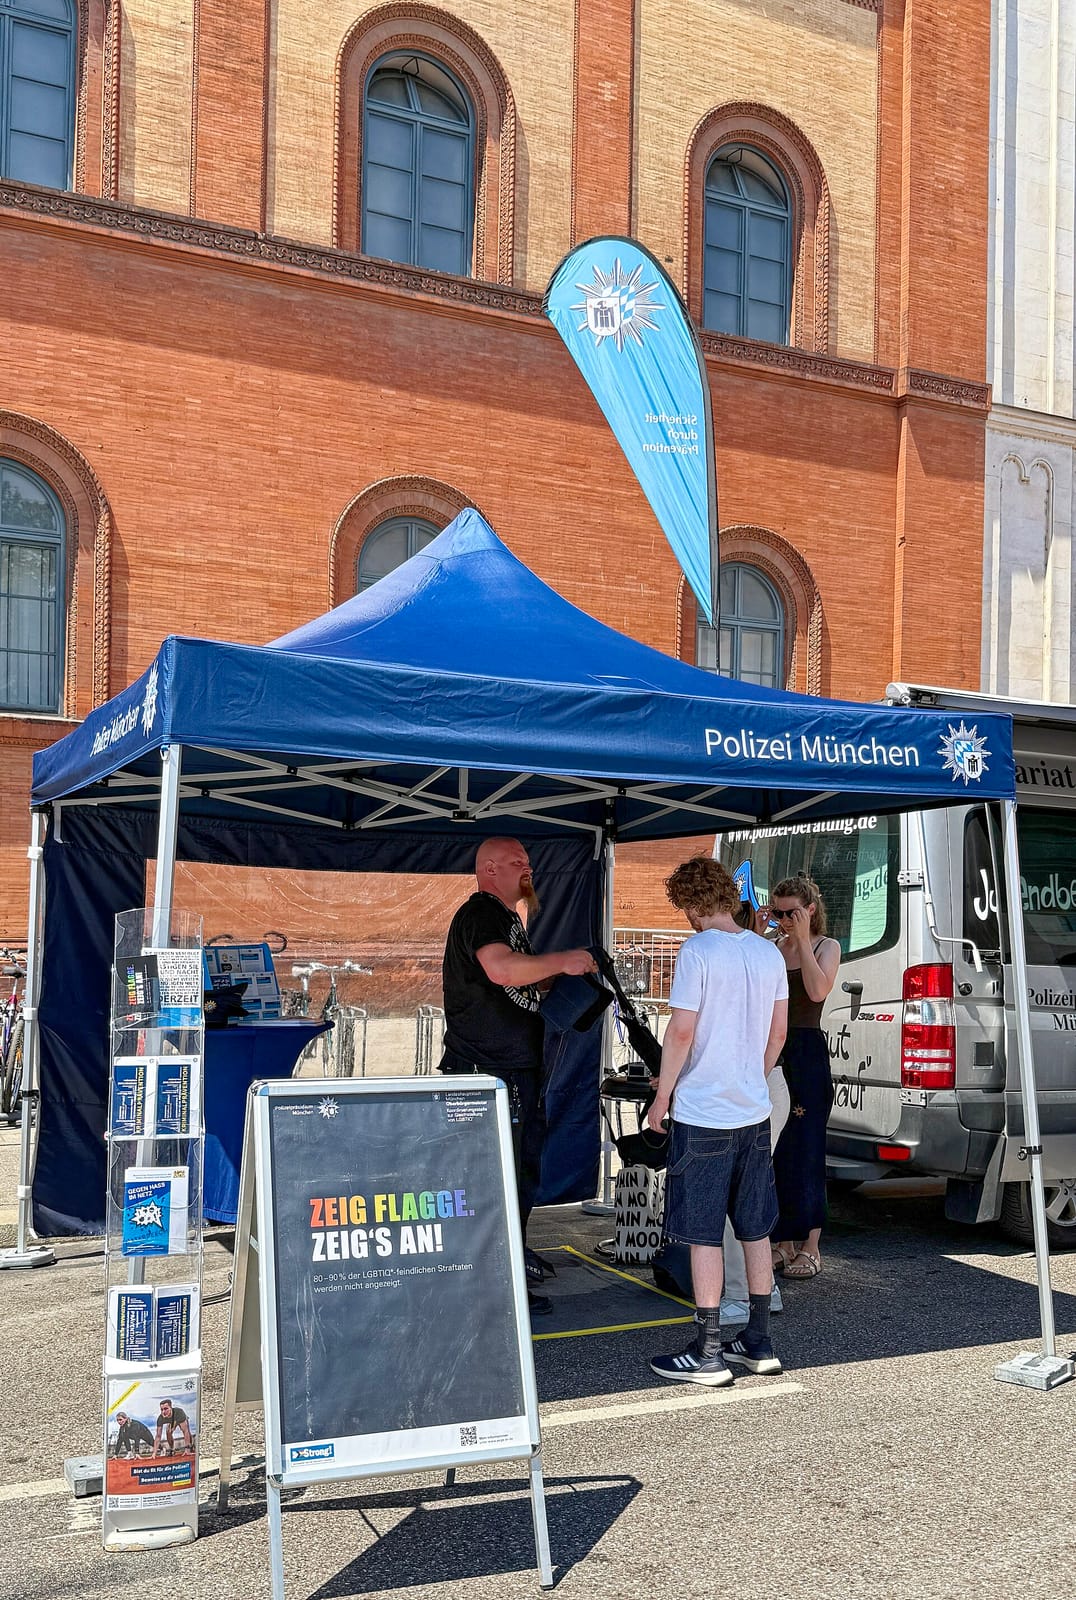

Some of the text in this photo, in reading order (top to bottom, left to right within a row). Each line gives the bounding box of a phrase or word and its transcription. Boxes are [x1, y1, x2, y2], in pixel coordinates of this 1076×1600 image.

[704, 728, 920, 767] Polizei München
[875, 1013, 895, 1023] CDI
[149, 1182, 166, 1190] HASS
[137, 1190, 153, 1199] NETZ
[309, 1189, 475, 1228] ZEIG FLAGGE.
[400, 1223, 444, 1255] AN!
[347, 1272, 361, 1280] der
[437, 1263, 473, 1273] Straftaten
[313, 1278, 403, 1293] werden nicht angezeigt.
[303, 1445, 332, 1458] Strong!
